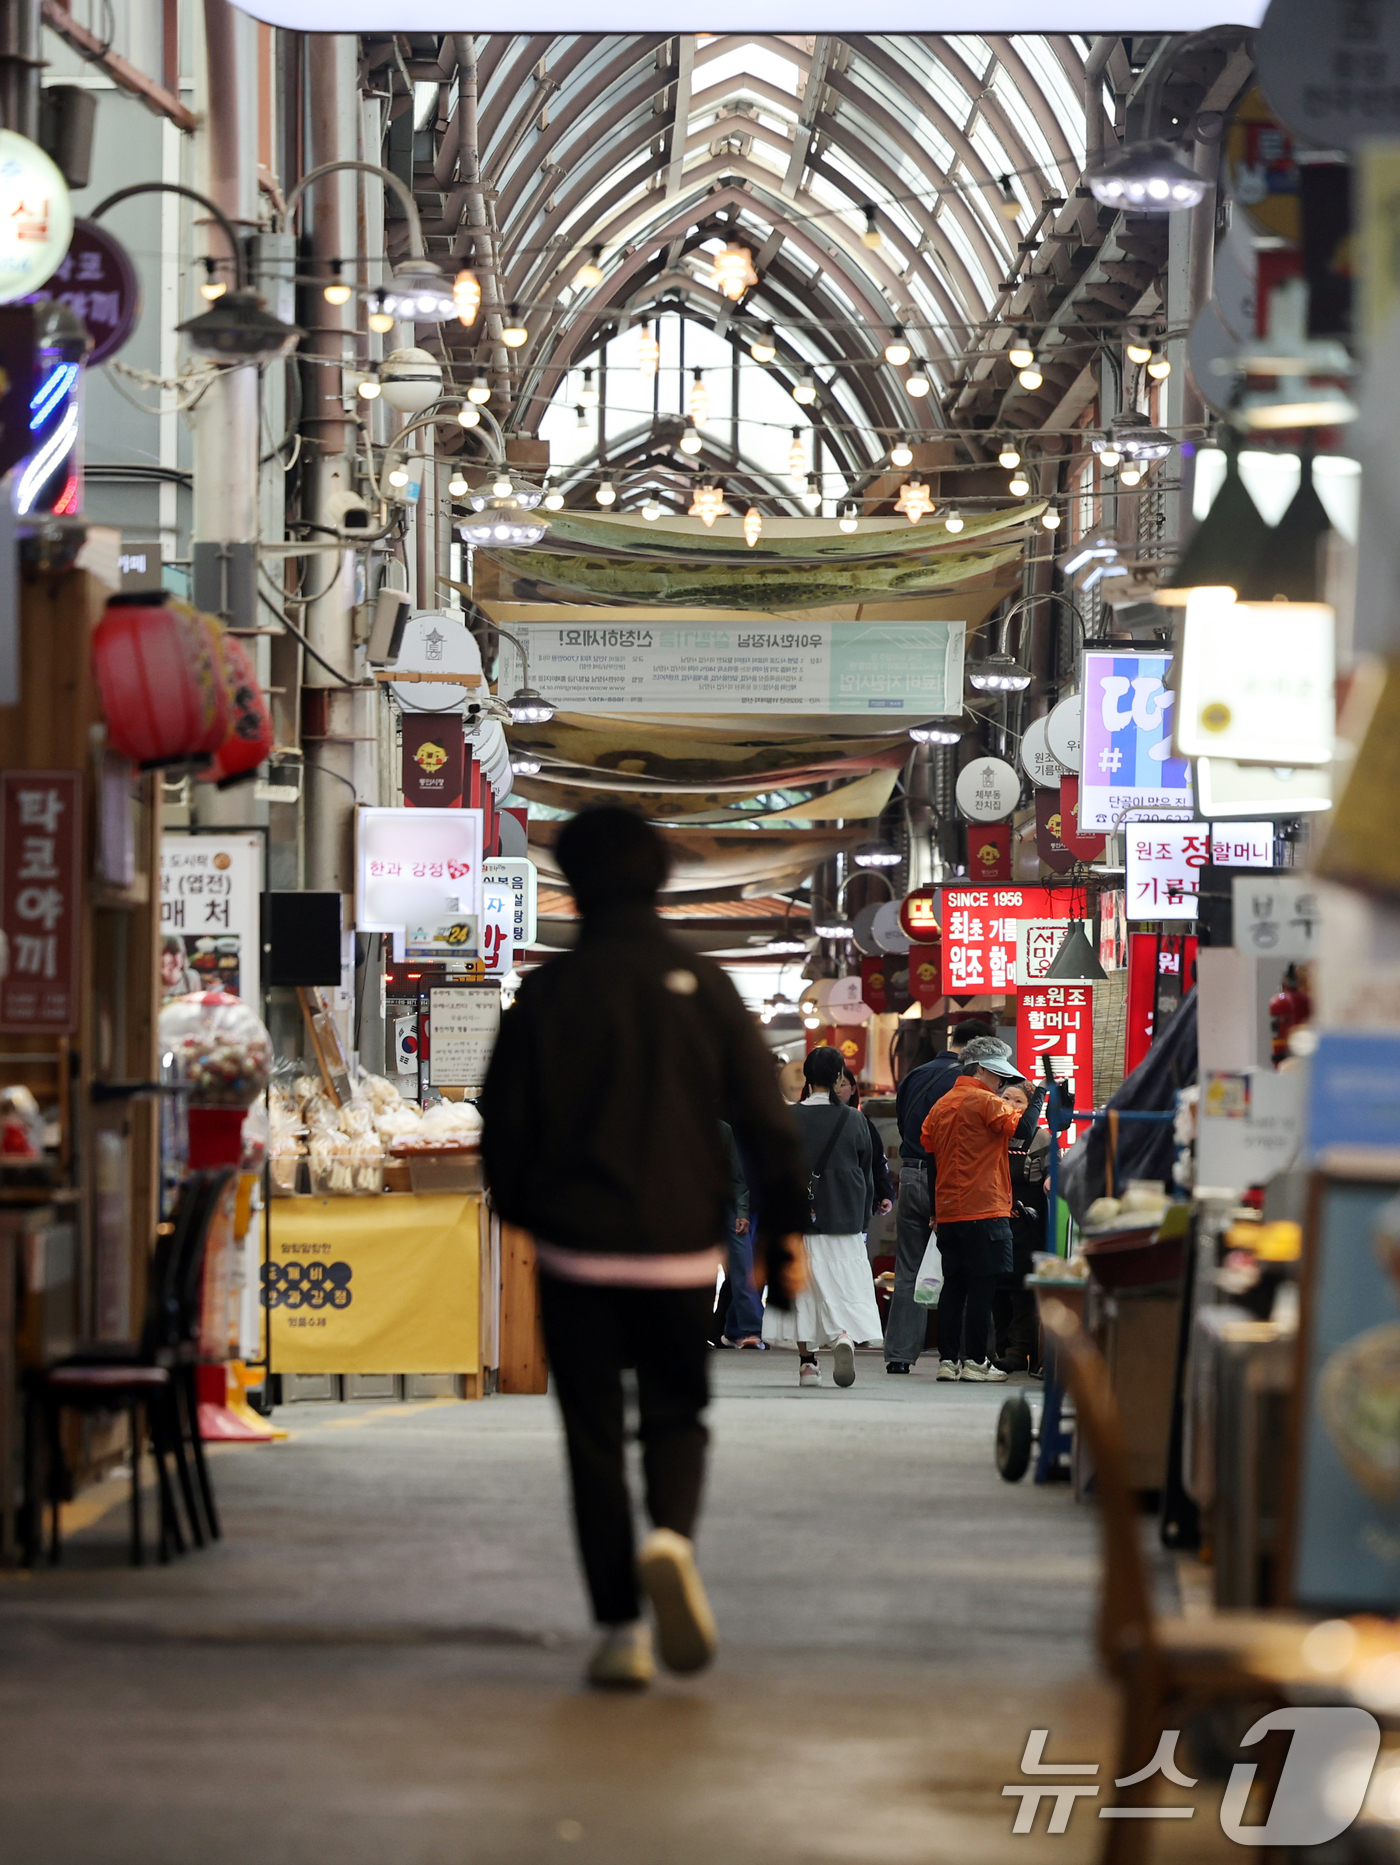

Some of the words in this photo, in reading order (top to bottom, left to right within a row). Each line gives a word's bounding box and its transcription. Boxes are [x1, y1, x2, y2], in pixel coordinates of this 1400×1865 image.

[1034, 752, 1055, 764] 원조
[974, 789, 1002, 799] 체부동
[1109, 795, 1144, 810] 단골이
[974, 800, 1002, 811] 잔치집
[1135, 841, 1173, 862] 원조
[370, 860, 402, 878] 한과
[412, 861, 444, 879] 강정
[15, 787, 65, 979] 타코야끼
[178, 874, 232, 895] (엽전)
[947, 892, 989, 907] SINCE
[992, 891, 1024, 907] 1956
[948, 910, 985, 944] 최초
[988, 917, 1017, 943] 기름
[948, 945, 985, 987] 원조
[988, 945, 1017, 988] 할머
[1027, 1010, 1081, 1030] 할머니
